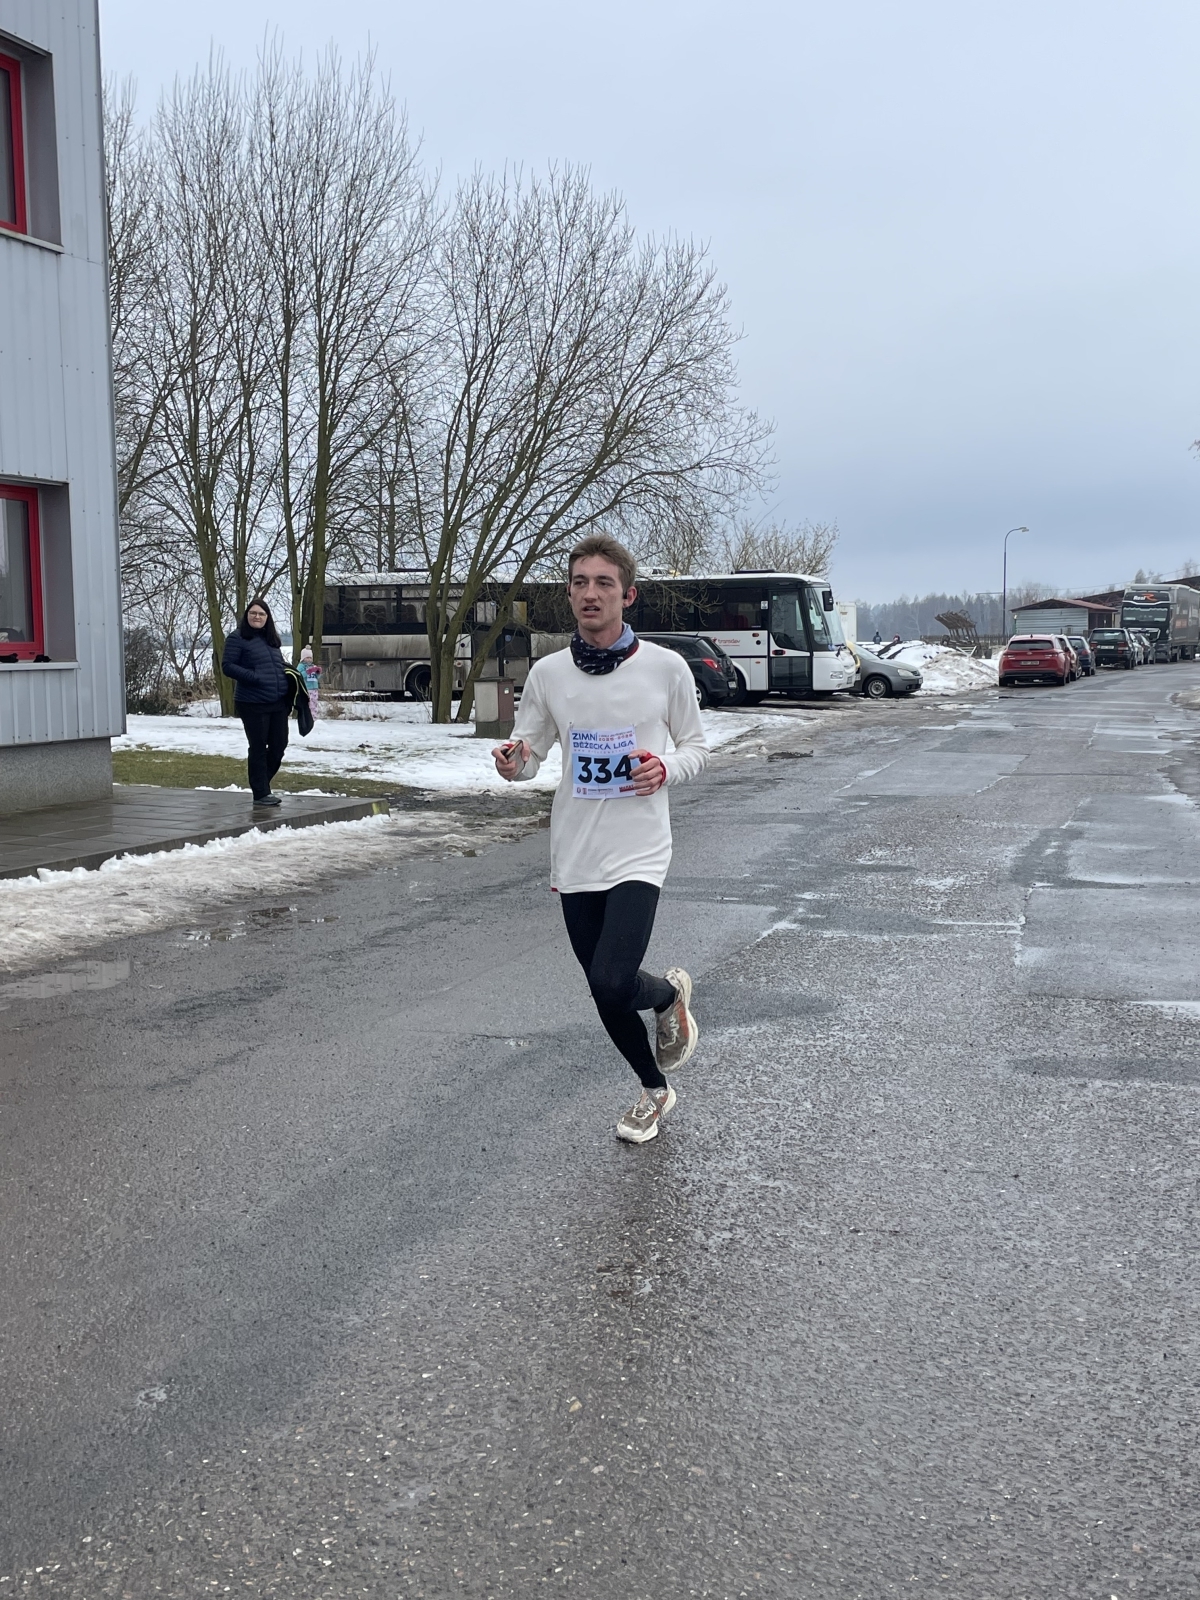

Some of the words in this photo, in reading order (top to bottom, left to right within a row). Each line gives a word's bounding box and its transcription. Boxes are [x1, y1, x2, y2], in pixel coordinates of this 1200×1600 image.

[572, 732, 598, 741] ZIMNÍ
[614, 740, 634, 749] LIGA
[578, 755, 633, 784] 334
